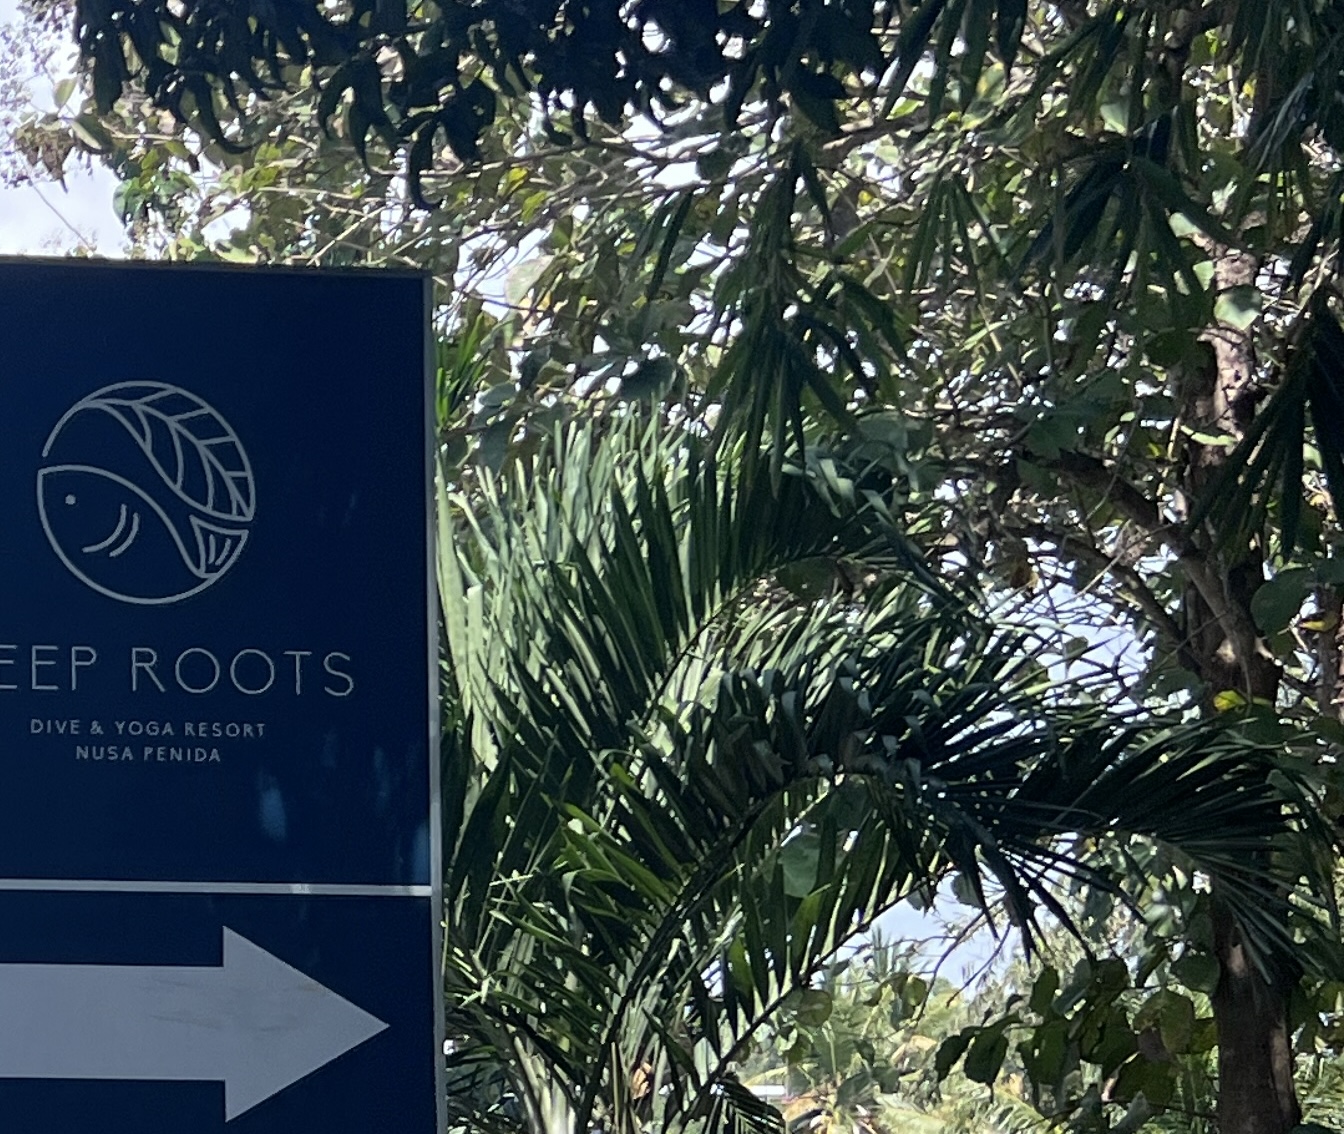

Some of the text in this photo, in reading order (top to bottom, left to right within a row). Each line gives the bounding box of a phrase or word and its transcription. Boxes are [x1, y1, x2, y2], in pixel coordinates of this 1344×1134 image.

[131, 647, 355, 696] ROOTS
[30, 718, 266, 738] DIVE & YOGA RESORT
[75, 746, 221, 762] NUSA PENIDA
